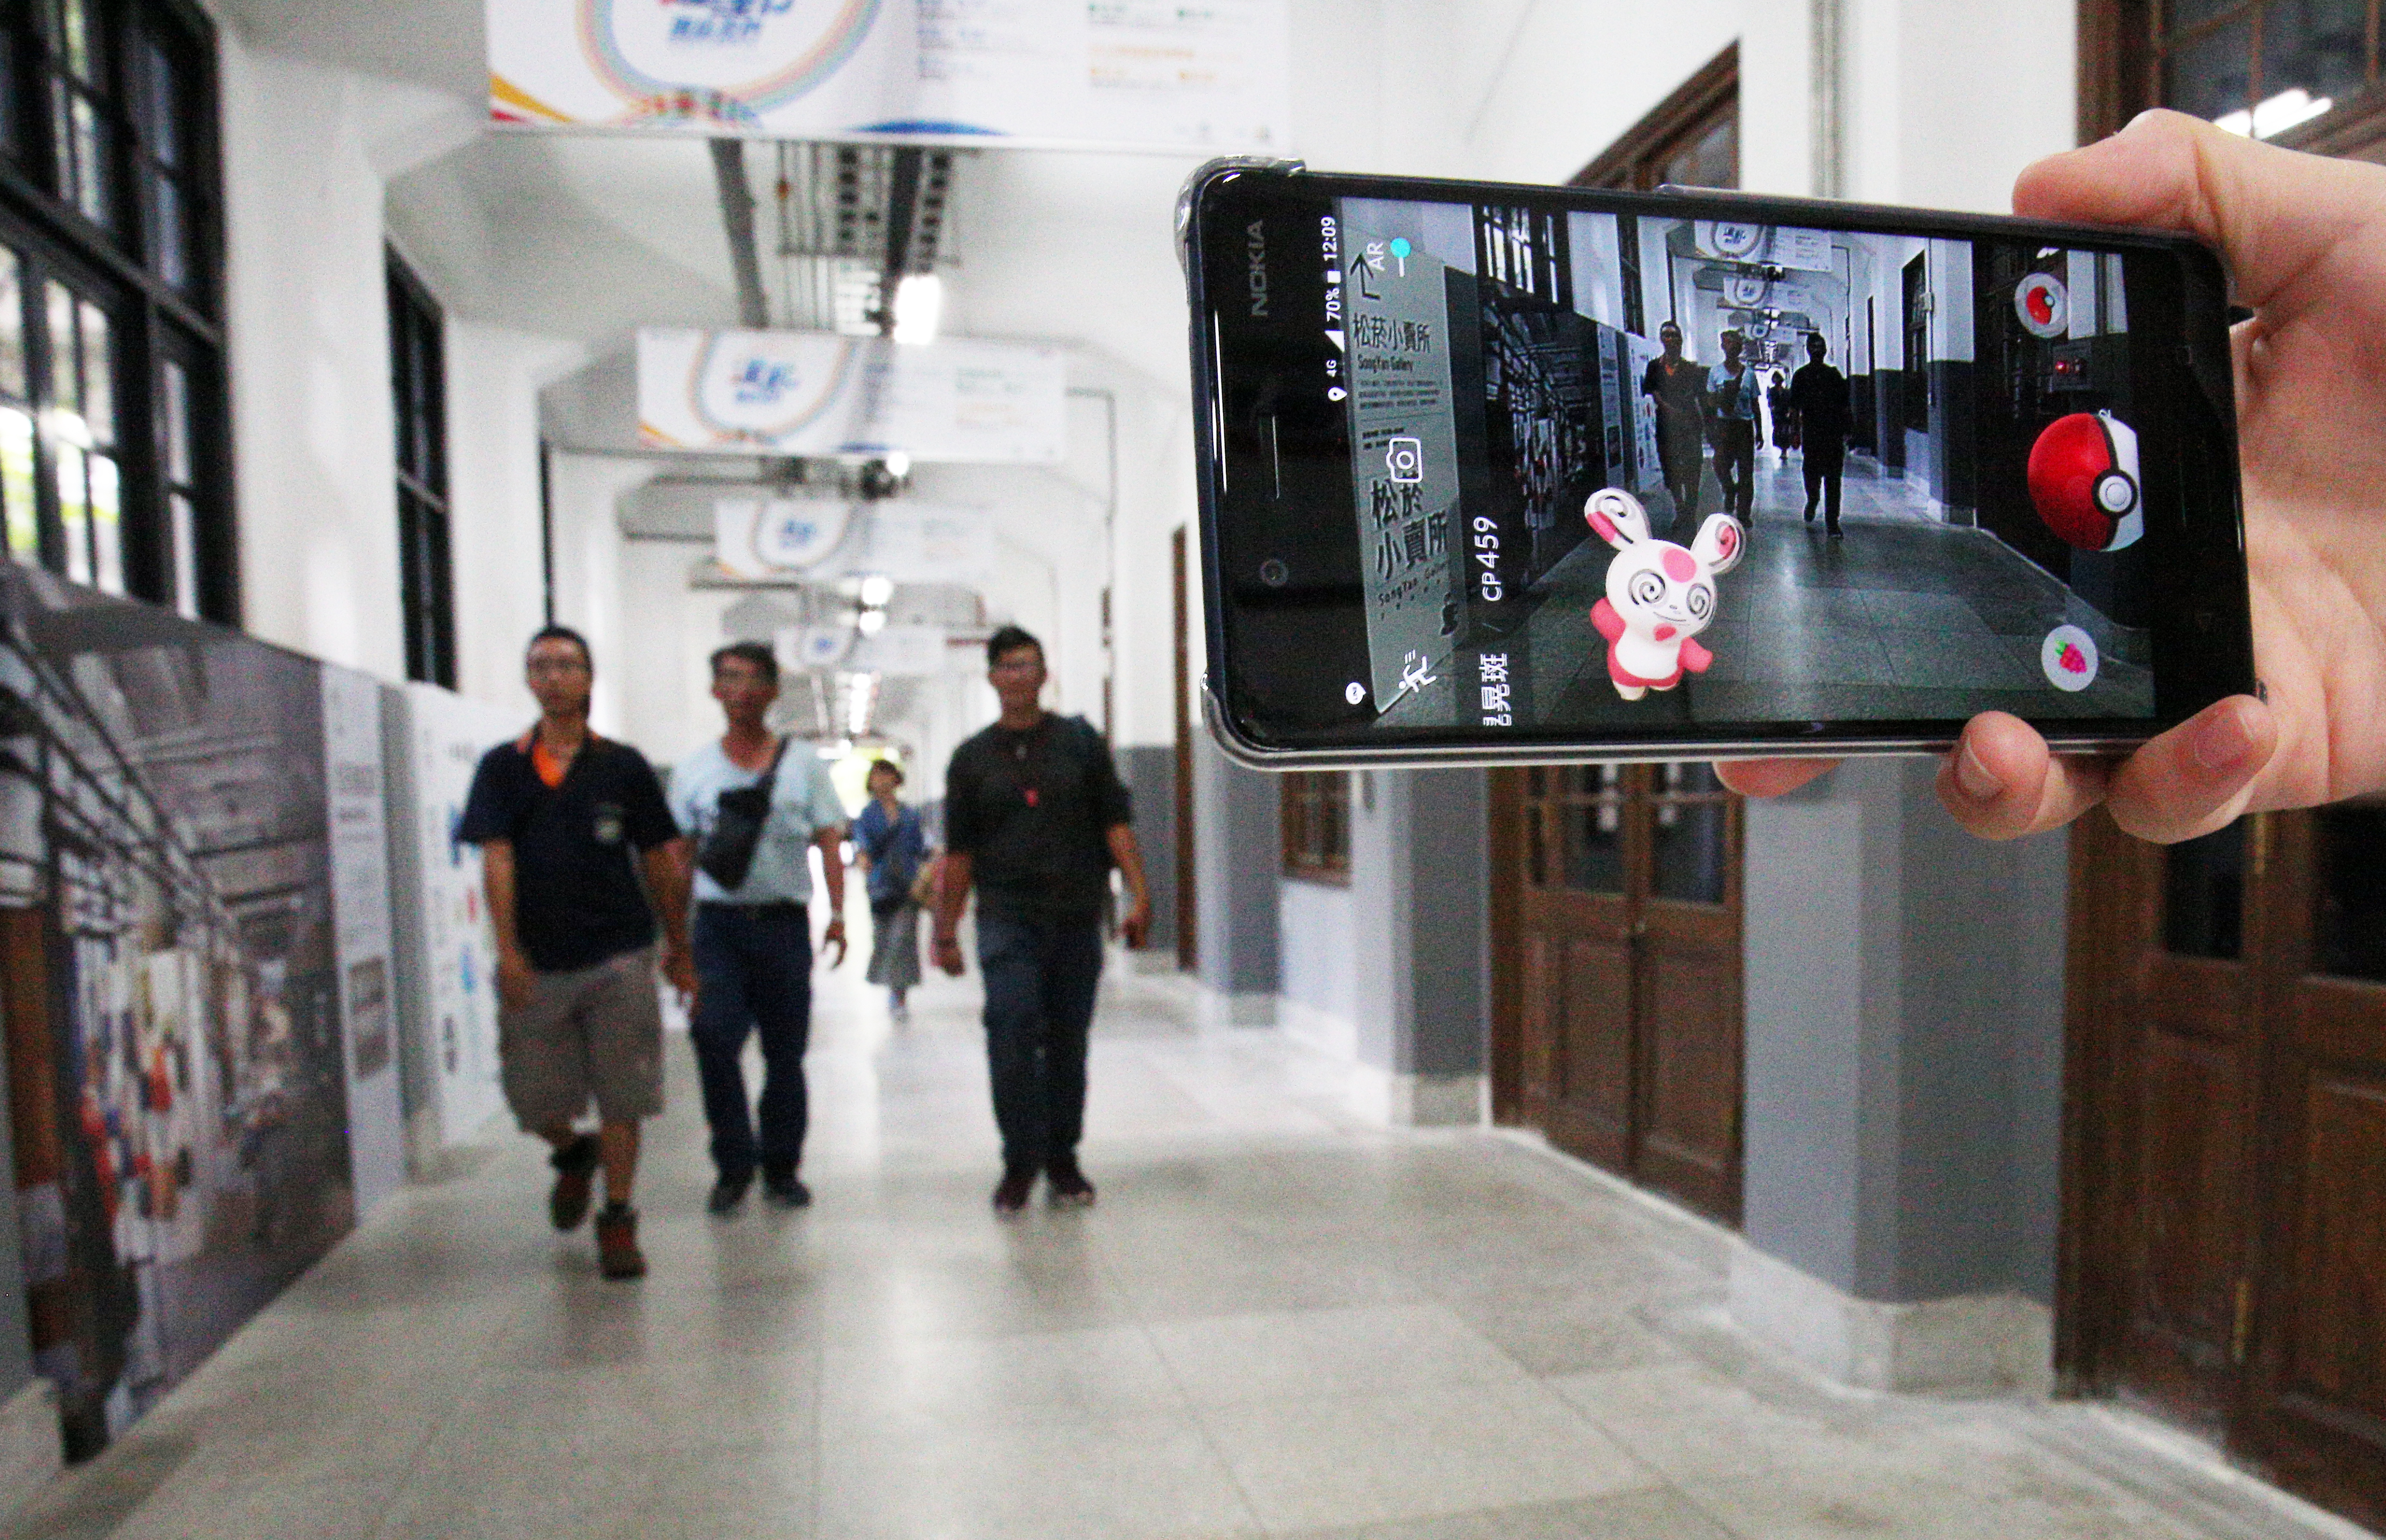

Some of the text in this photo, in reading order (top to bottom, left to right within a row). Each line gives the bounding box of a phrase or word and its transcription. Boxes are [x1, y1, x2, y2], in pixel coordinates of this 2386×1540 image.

[1247, 220, 1269, 318] NOKIA
[1321, 216, 1342, 378] 4G 70% 12:09
[1366, 242, 1386, 272] AR
